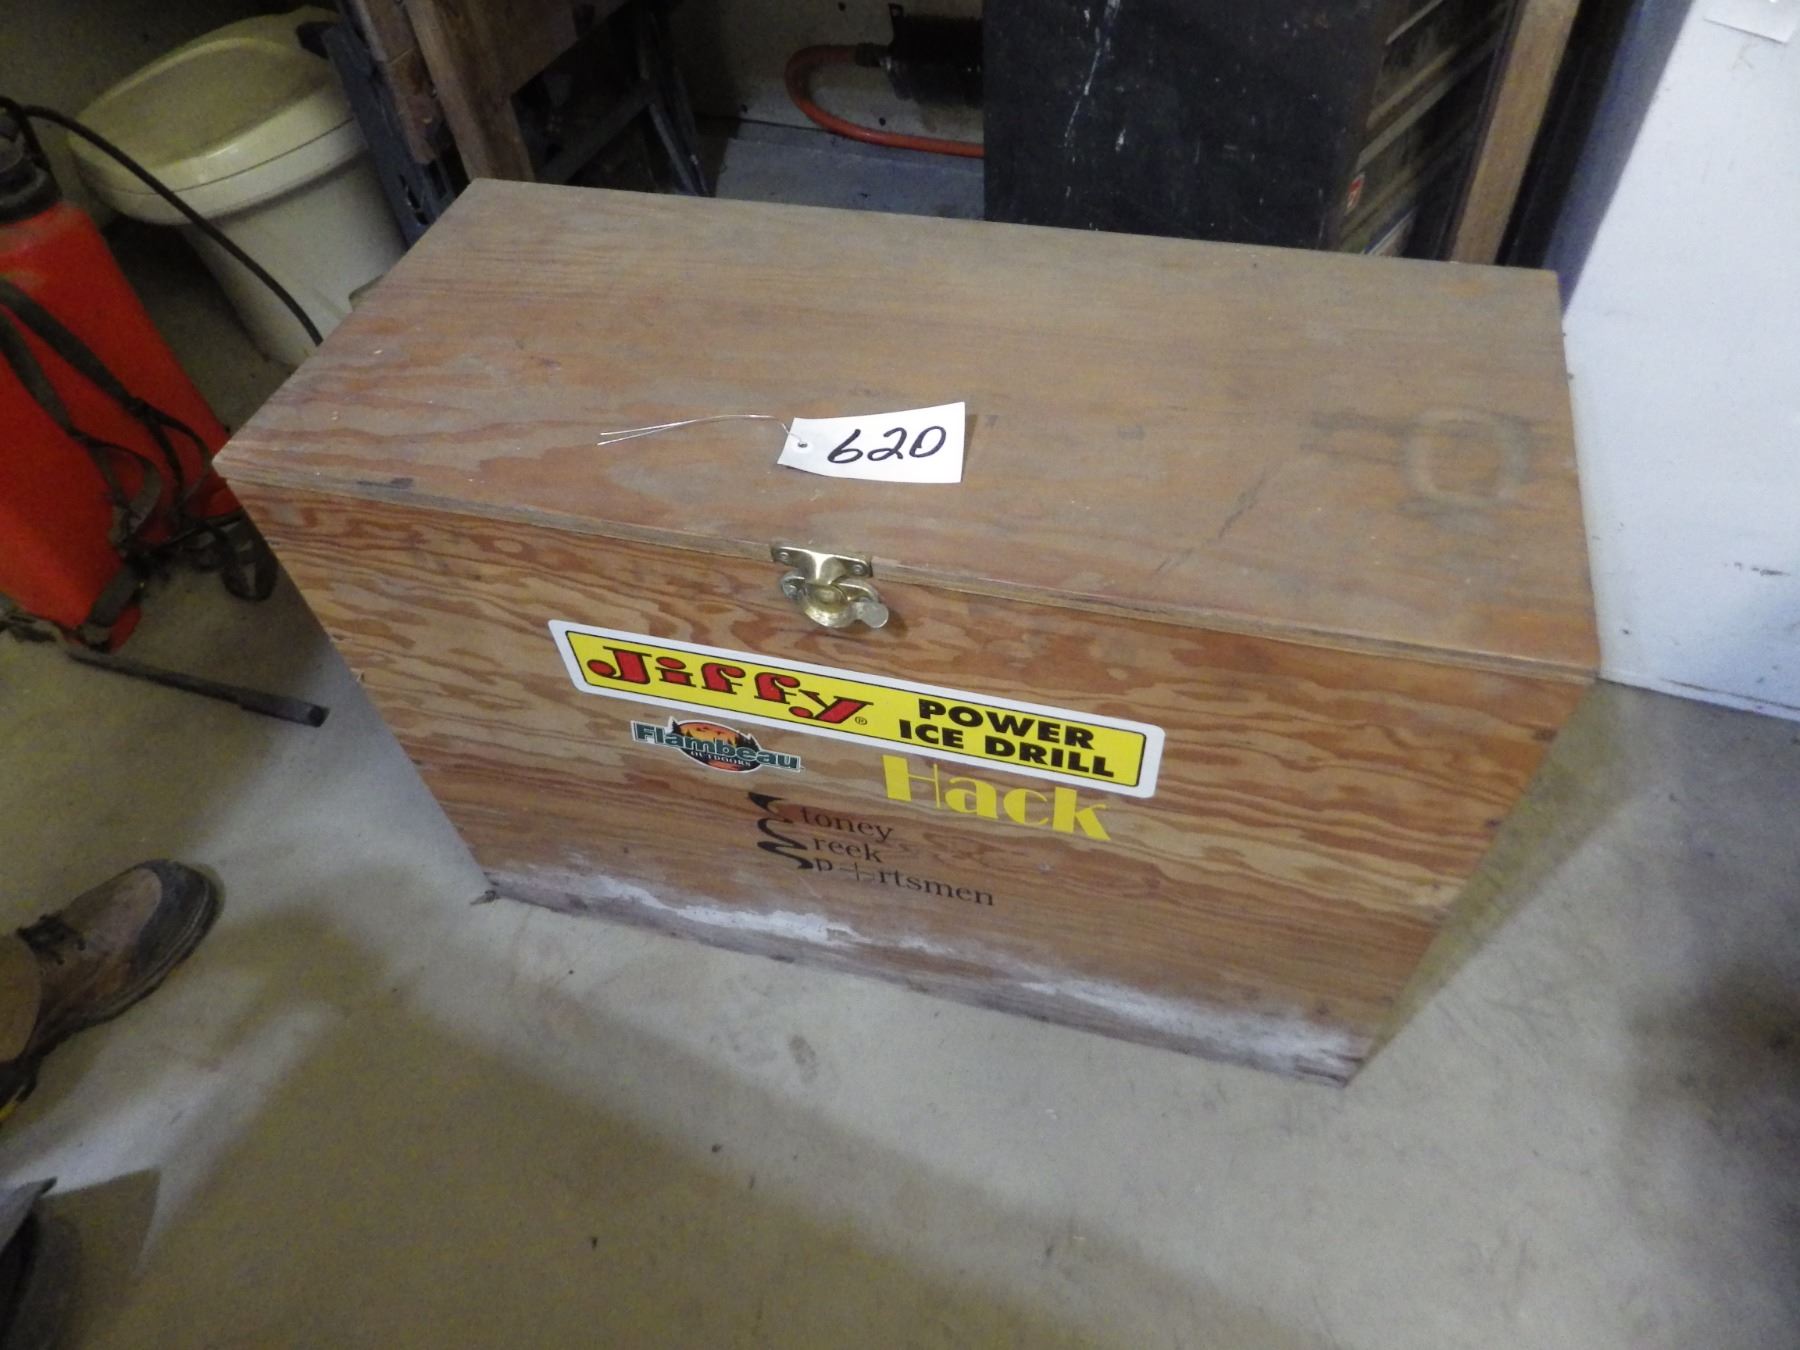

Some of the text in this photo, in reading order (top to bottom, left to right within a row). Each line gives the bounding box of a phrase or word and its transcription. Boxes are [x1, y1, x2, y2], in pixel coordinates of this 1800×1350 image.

[826, 425, 947, 464] 620
[586, 645, 874, 725] Jiffy
[634, 722, 801, 770] Flambeau
[898, 718, 1115, 778] ICE DRILL
[918, 698, 1095, 751] POWER
[881, 754, 1111, 841] Hack
